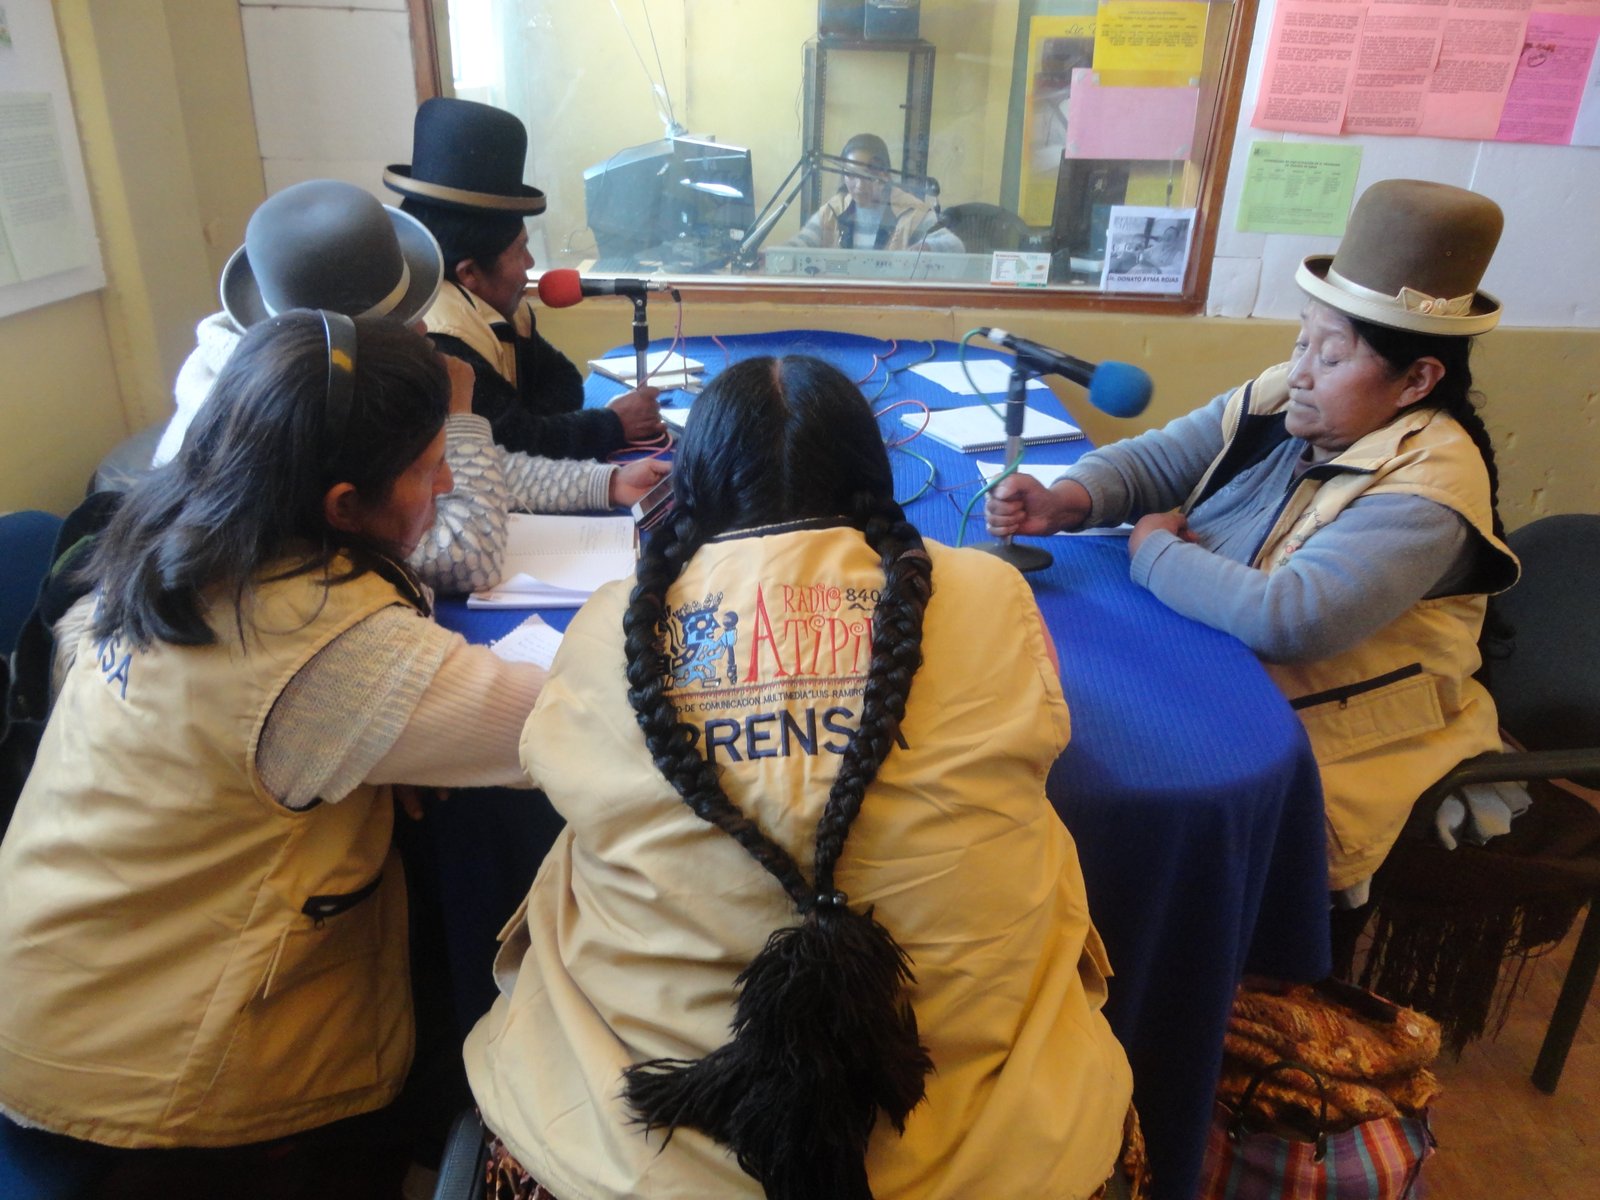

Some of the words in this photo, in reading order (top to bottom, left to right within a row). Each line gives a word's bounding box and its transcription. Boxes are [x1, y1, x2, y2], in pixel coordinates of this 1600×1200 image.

[845, 587, 881, 603] 840
[684, 703, 696, 713] DE
[699, 696, 761, 711] COMUNICACION
[763, 691, 808, 705] MULTIMEDIA
[832, 687, 866, 699] RAMIRO
[679, 706, 909, 764] PRENS
